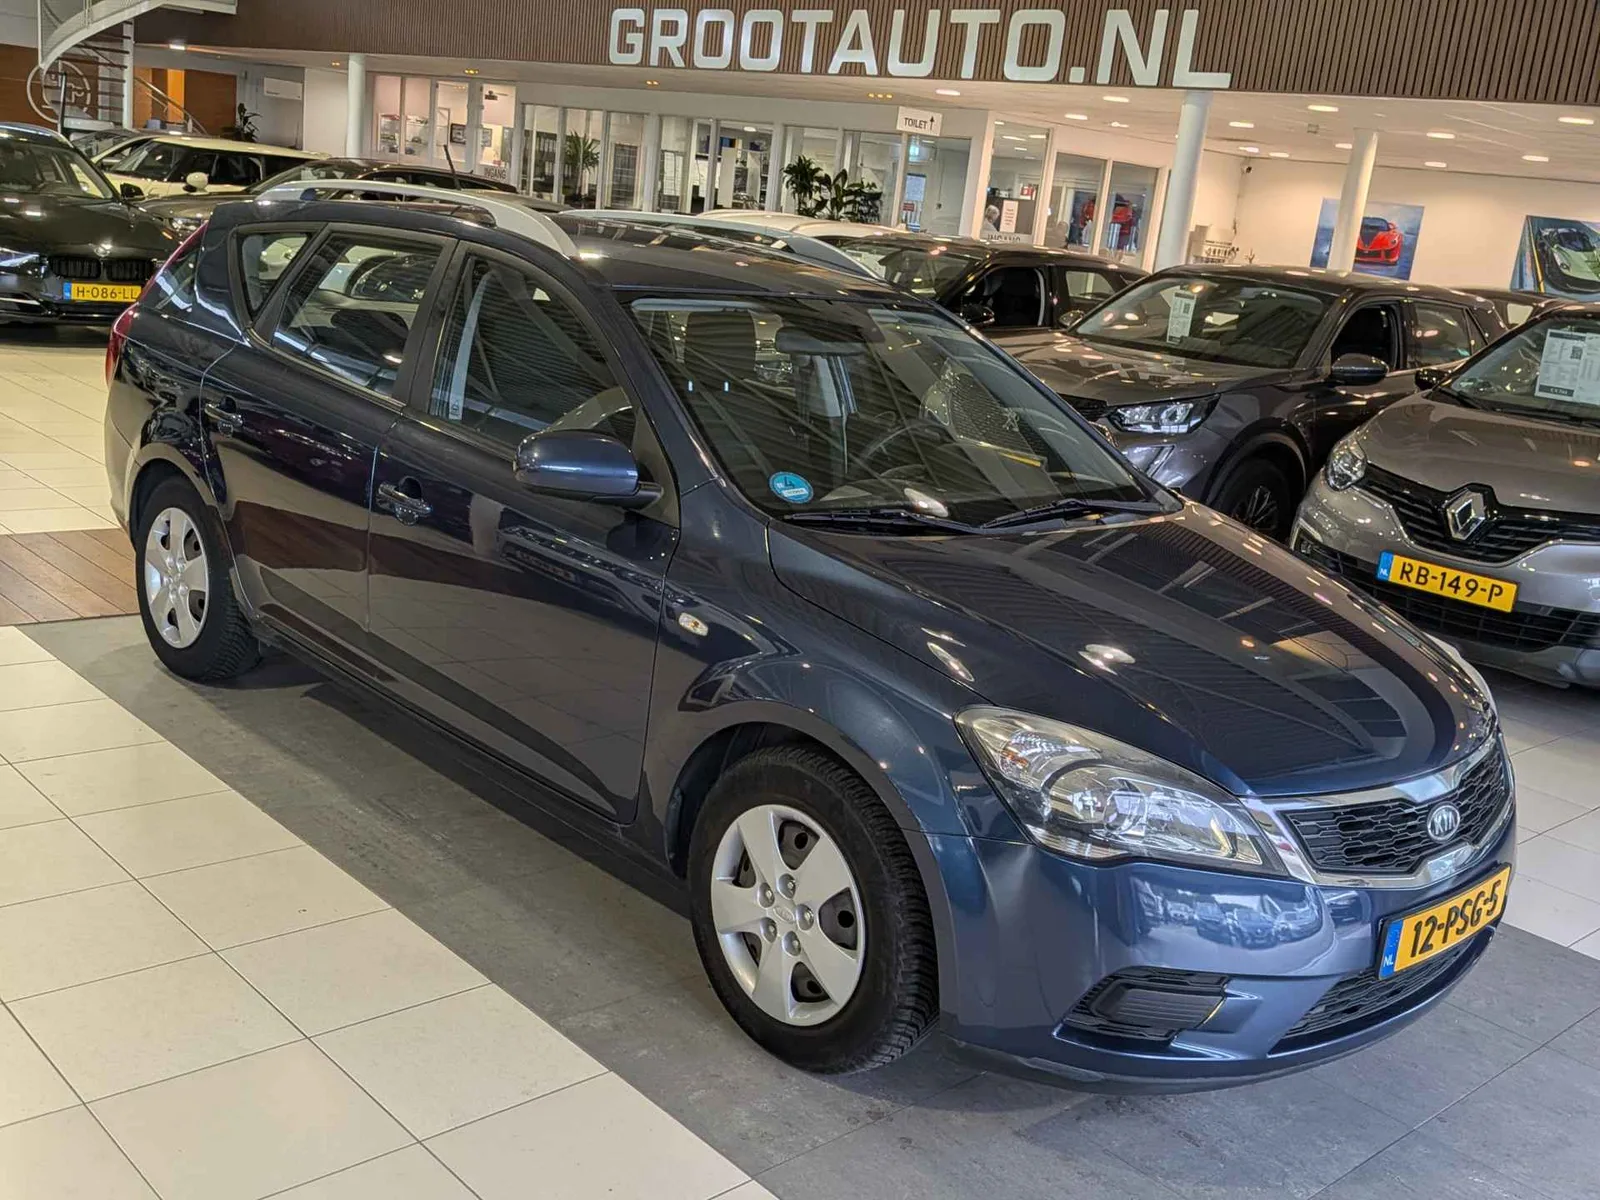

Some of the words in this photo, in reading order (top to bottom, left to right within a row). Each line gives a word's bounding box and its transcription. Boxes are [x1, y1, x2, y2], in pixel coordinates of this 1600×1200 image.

[609, 8, 1232, 88] GROOTAUTO.NL
[904, 117, 928, 130] TOILET
[484, 167, 507, 180] INGANG
[76, 286, 137, 300] H-086-LL
[1379, 567, 1389, 576] NL
[1399, 561, 1504, 603] RB-149-P
[1433, 806, 1457, 836] KIA
[1410, 879, 1502, 959] 12-PSG-5
[1383, 953, 1394, 967] NL
